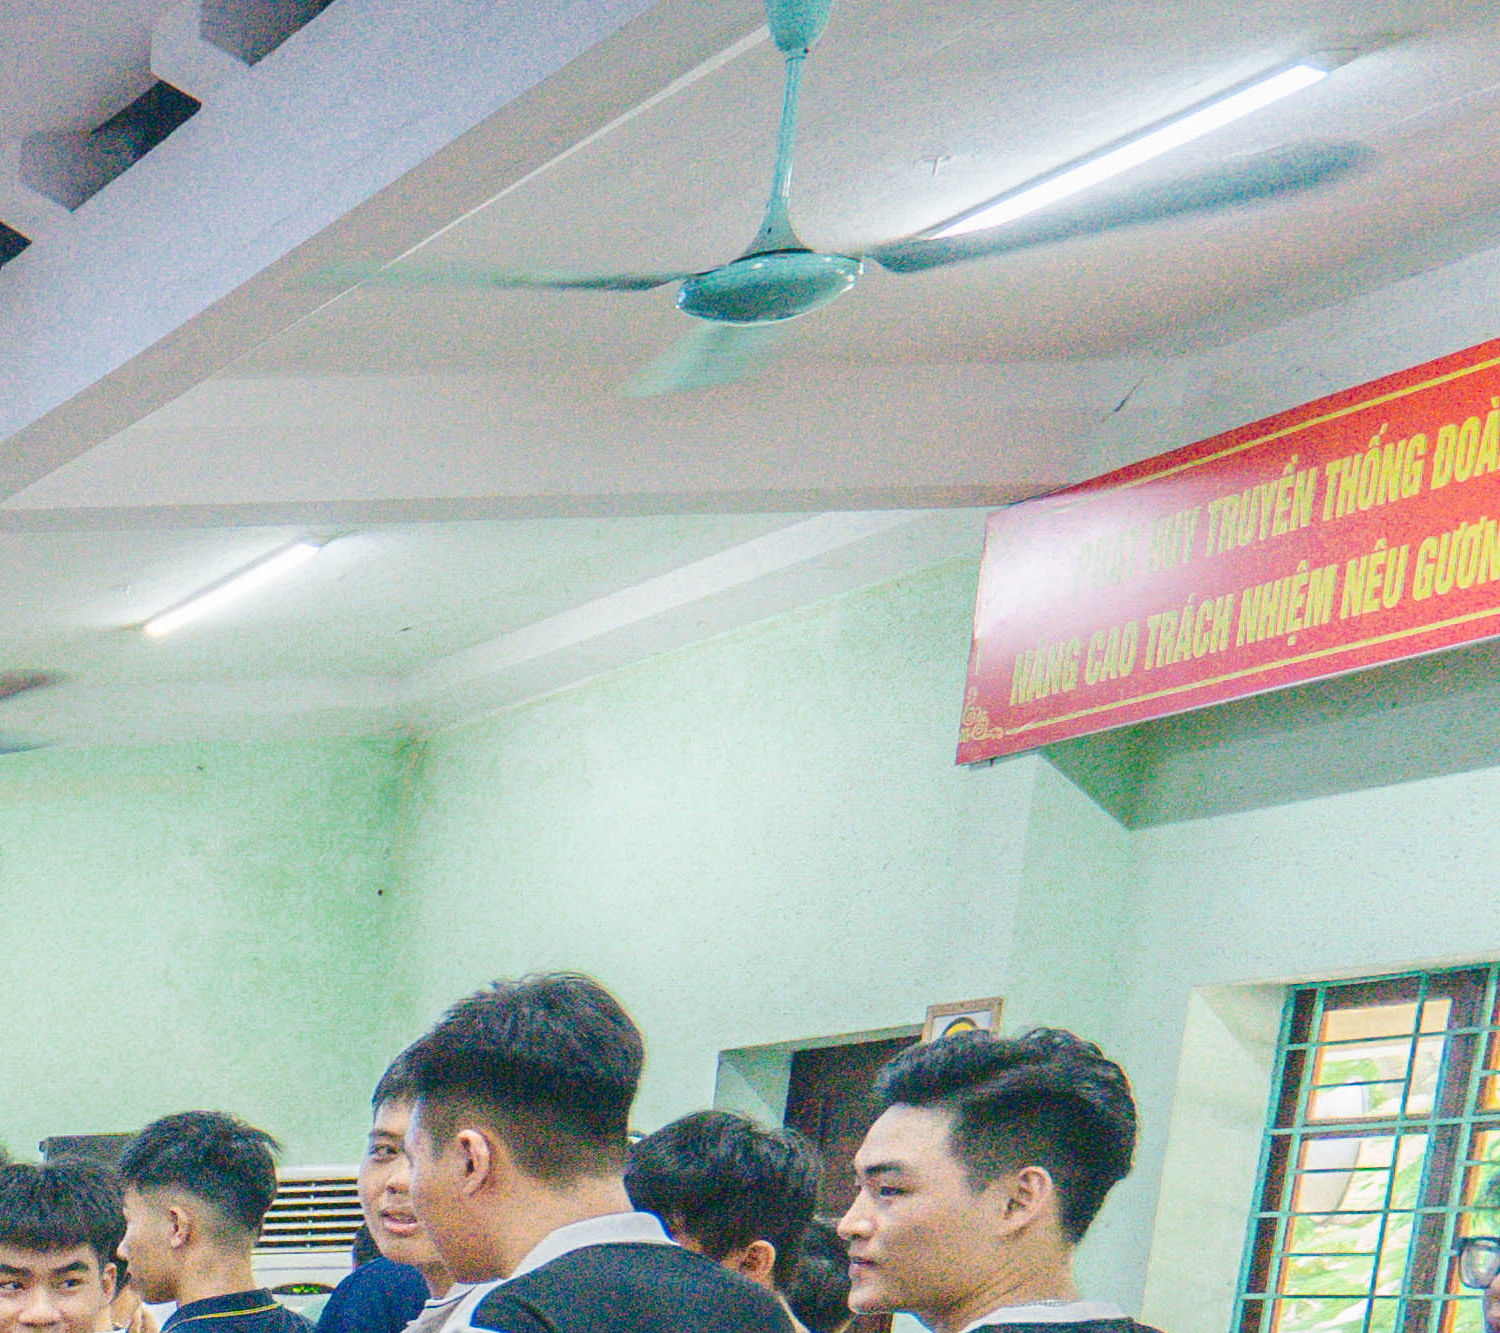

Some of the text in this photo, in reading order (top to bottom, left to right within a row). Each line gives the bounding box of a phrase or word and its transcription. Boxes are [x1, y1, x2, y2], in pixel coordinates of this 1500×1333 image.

[1206, 454, 1317, 558] TRUYỀN
[1085, 627, 1137, 687] CAO
[1144, 593, 1235, 672] TRÁCH
[1236, 559, 1336, 647] NHIỆM
[1340, 538, 1410, 620] NÊU
